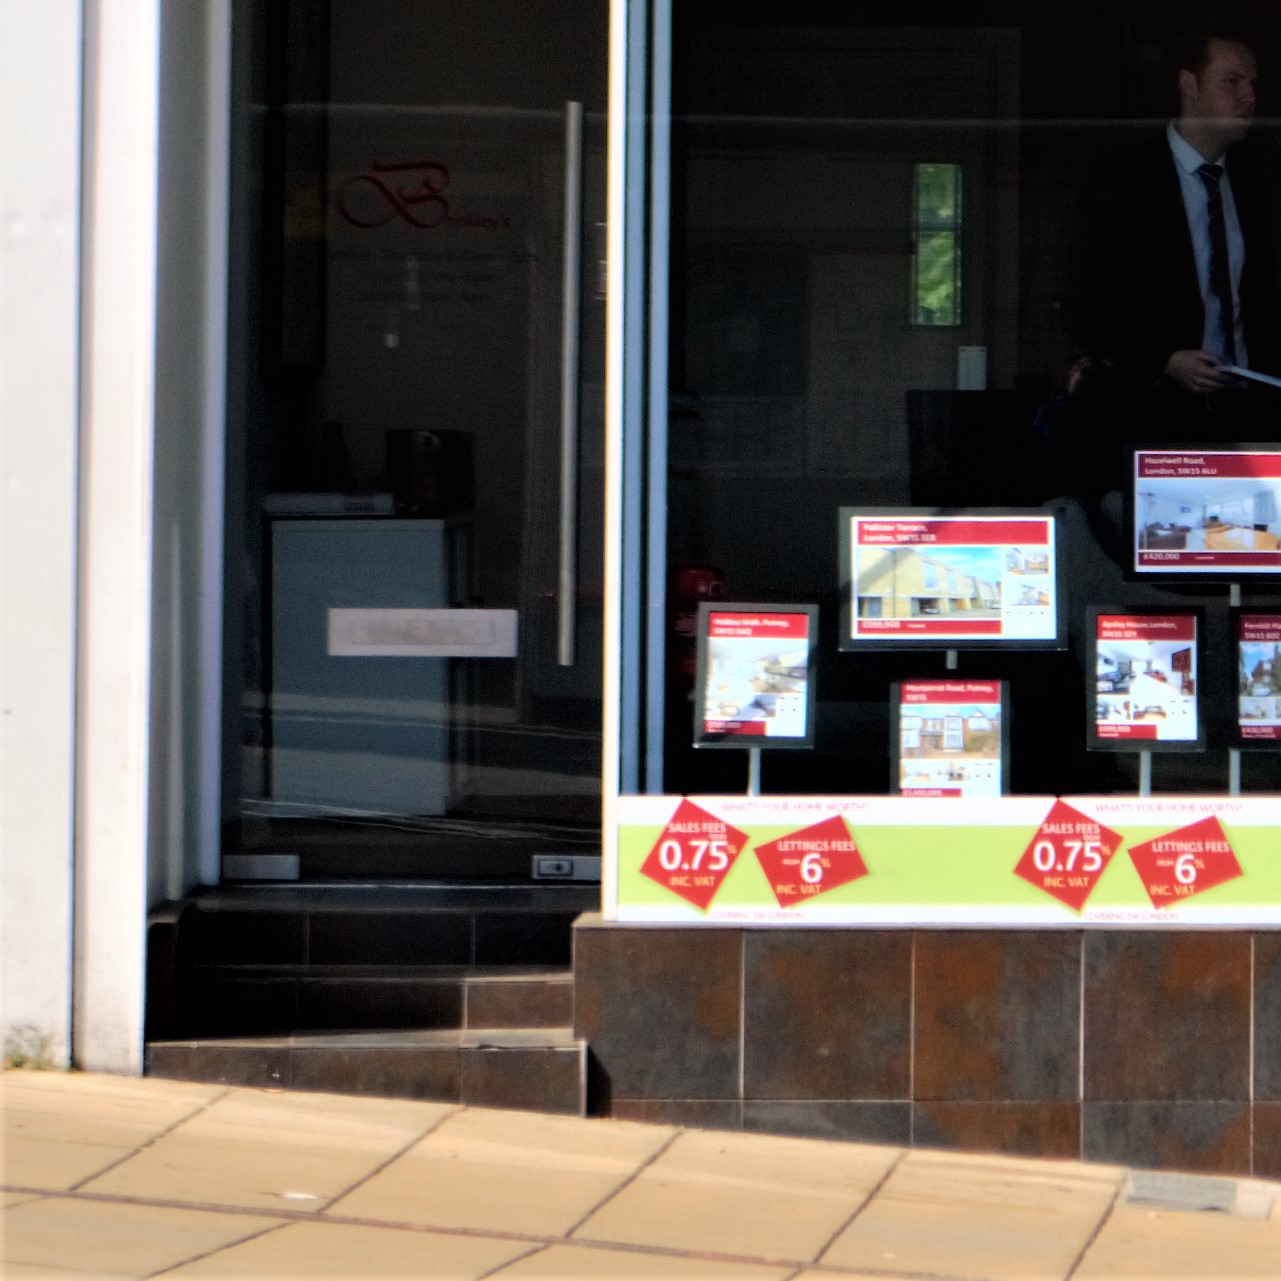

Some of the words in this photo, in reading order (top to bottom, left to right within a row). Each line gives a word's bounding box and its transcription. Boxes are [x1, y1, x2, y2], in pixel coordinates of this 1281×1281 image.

[667, 823, 700, 833] SALES
[702, 823, 727, 833] FEES
[1041, 824, 1074, 834] SALES
[1076, 824, 1100, 834] FEES
[777, 840, 829, 852] LETTINGS
[830, 840, 855, 852] FEES
[1151, 842, 1203, 852] LETTINGS
[1205, 842, 1229, 852] FEES
[693, 876, 715, 886] VAT
[1067, 877, 1089, 887] VAT
[800, 884, 822, 895] VAT
[1174, 885, 1195, 896] VAT
